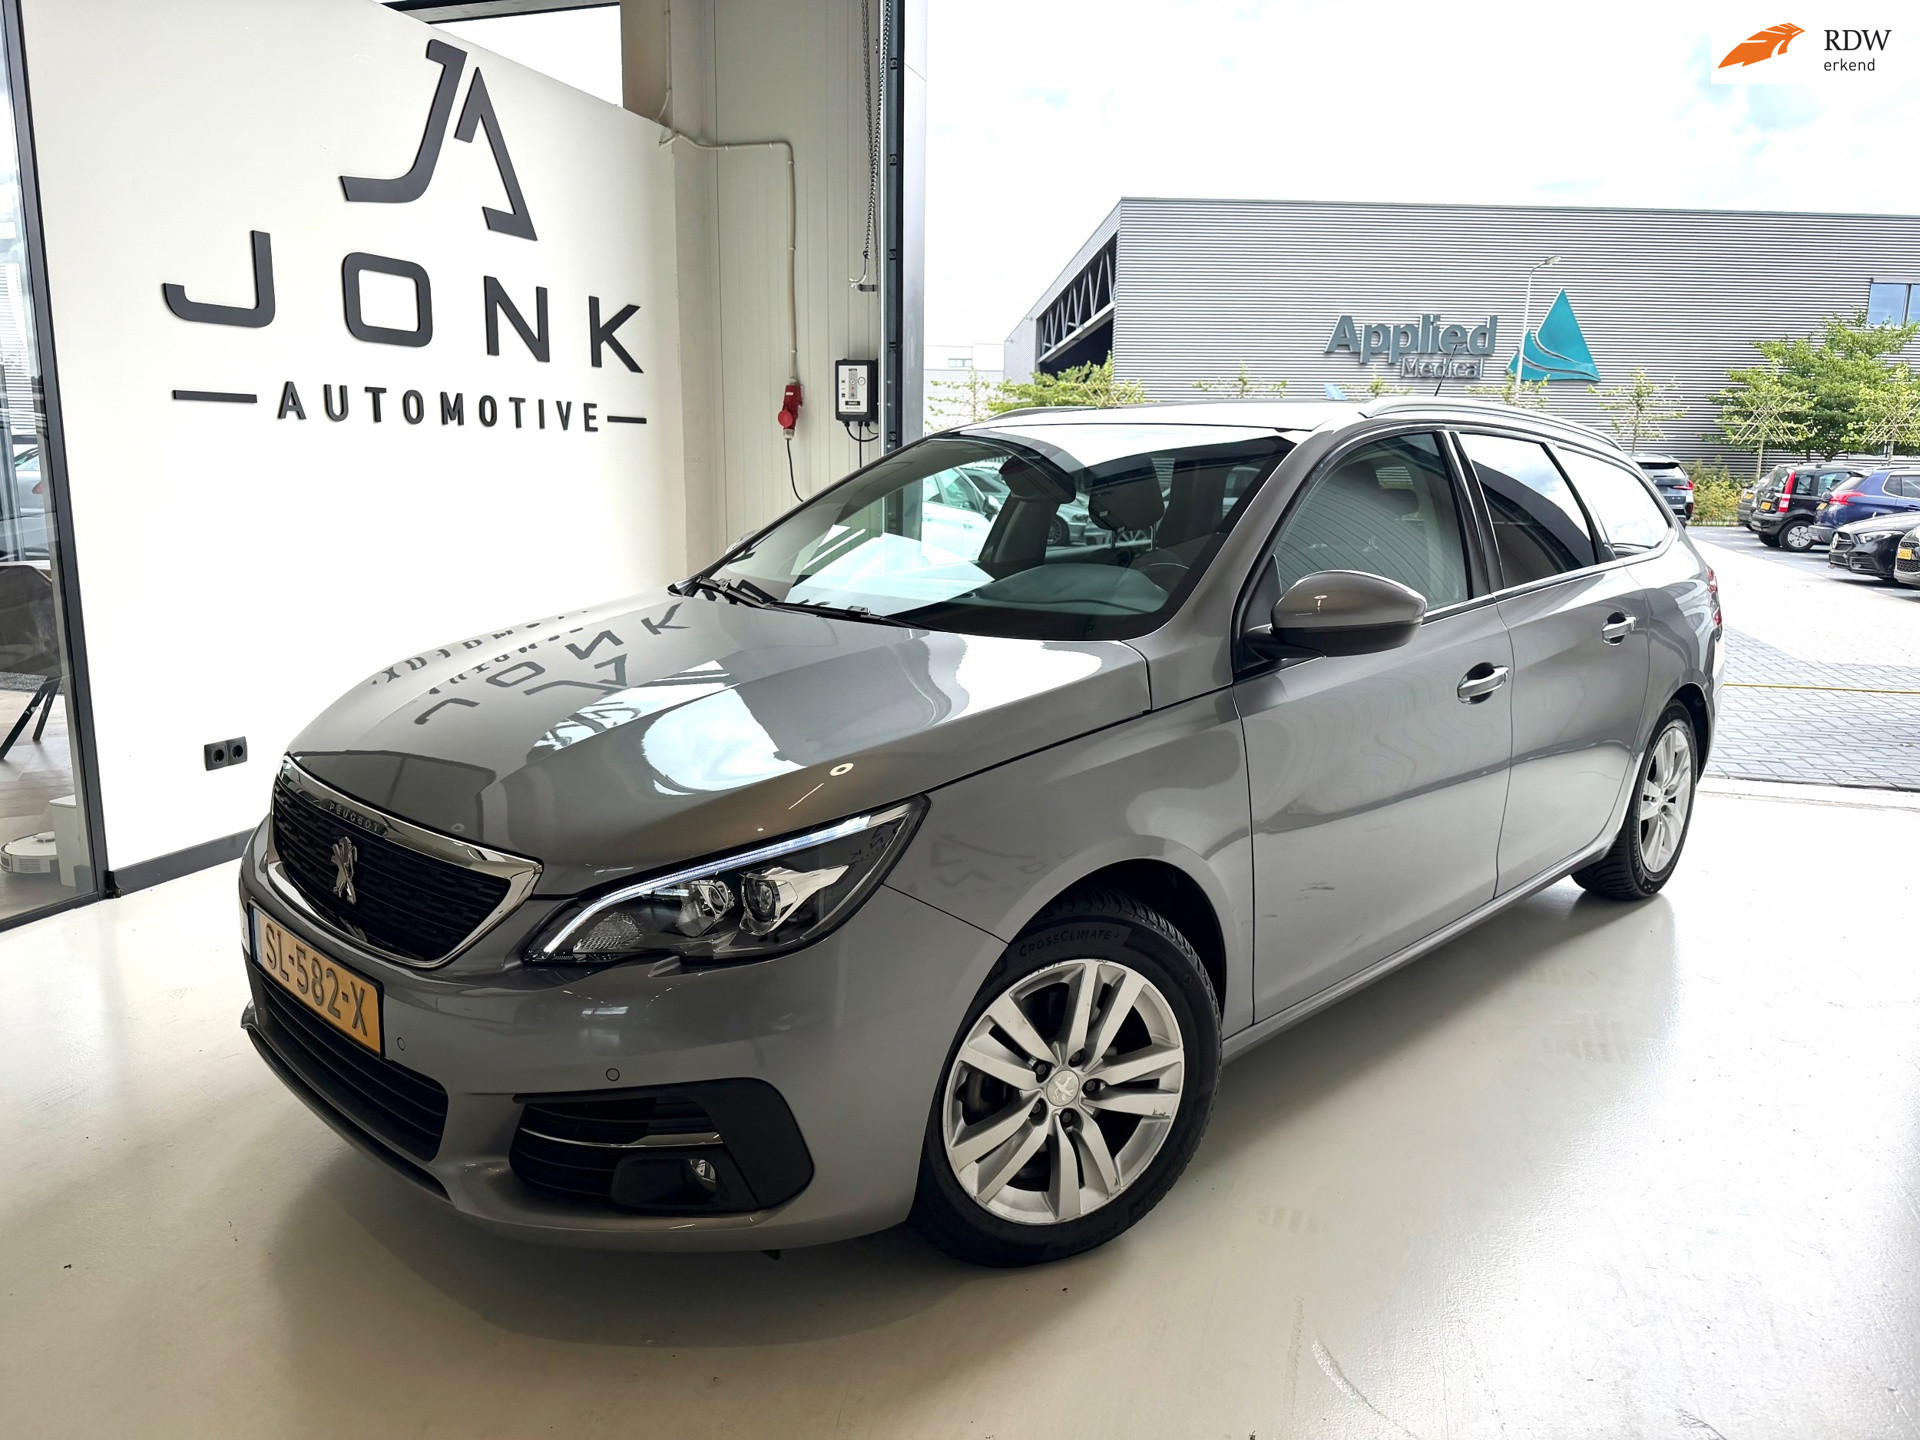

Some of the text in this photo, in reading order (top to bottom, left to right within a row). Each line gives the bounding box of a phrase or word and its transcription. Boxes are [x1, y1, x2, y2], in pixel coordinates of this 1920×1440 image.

[162, 229, 645, 374] JONK
[1323, 313, 1499, 365] Applied
[1400, 356, 1484, 379] Medical
[277, 380, 600, 433] AUTOMOTIVE
[328, 802, 380, 832] PEUGEOT
[265, 922, 368, 1038] SL-582-X
